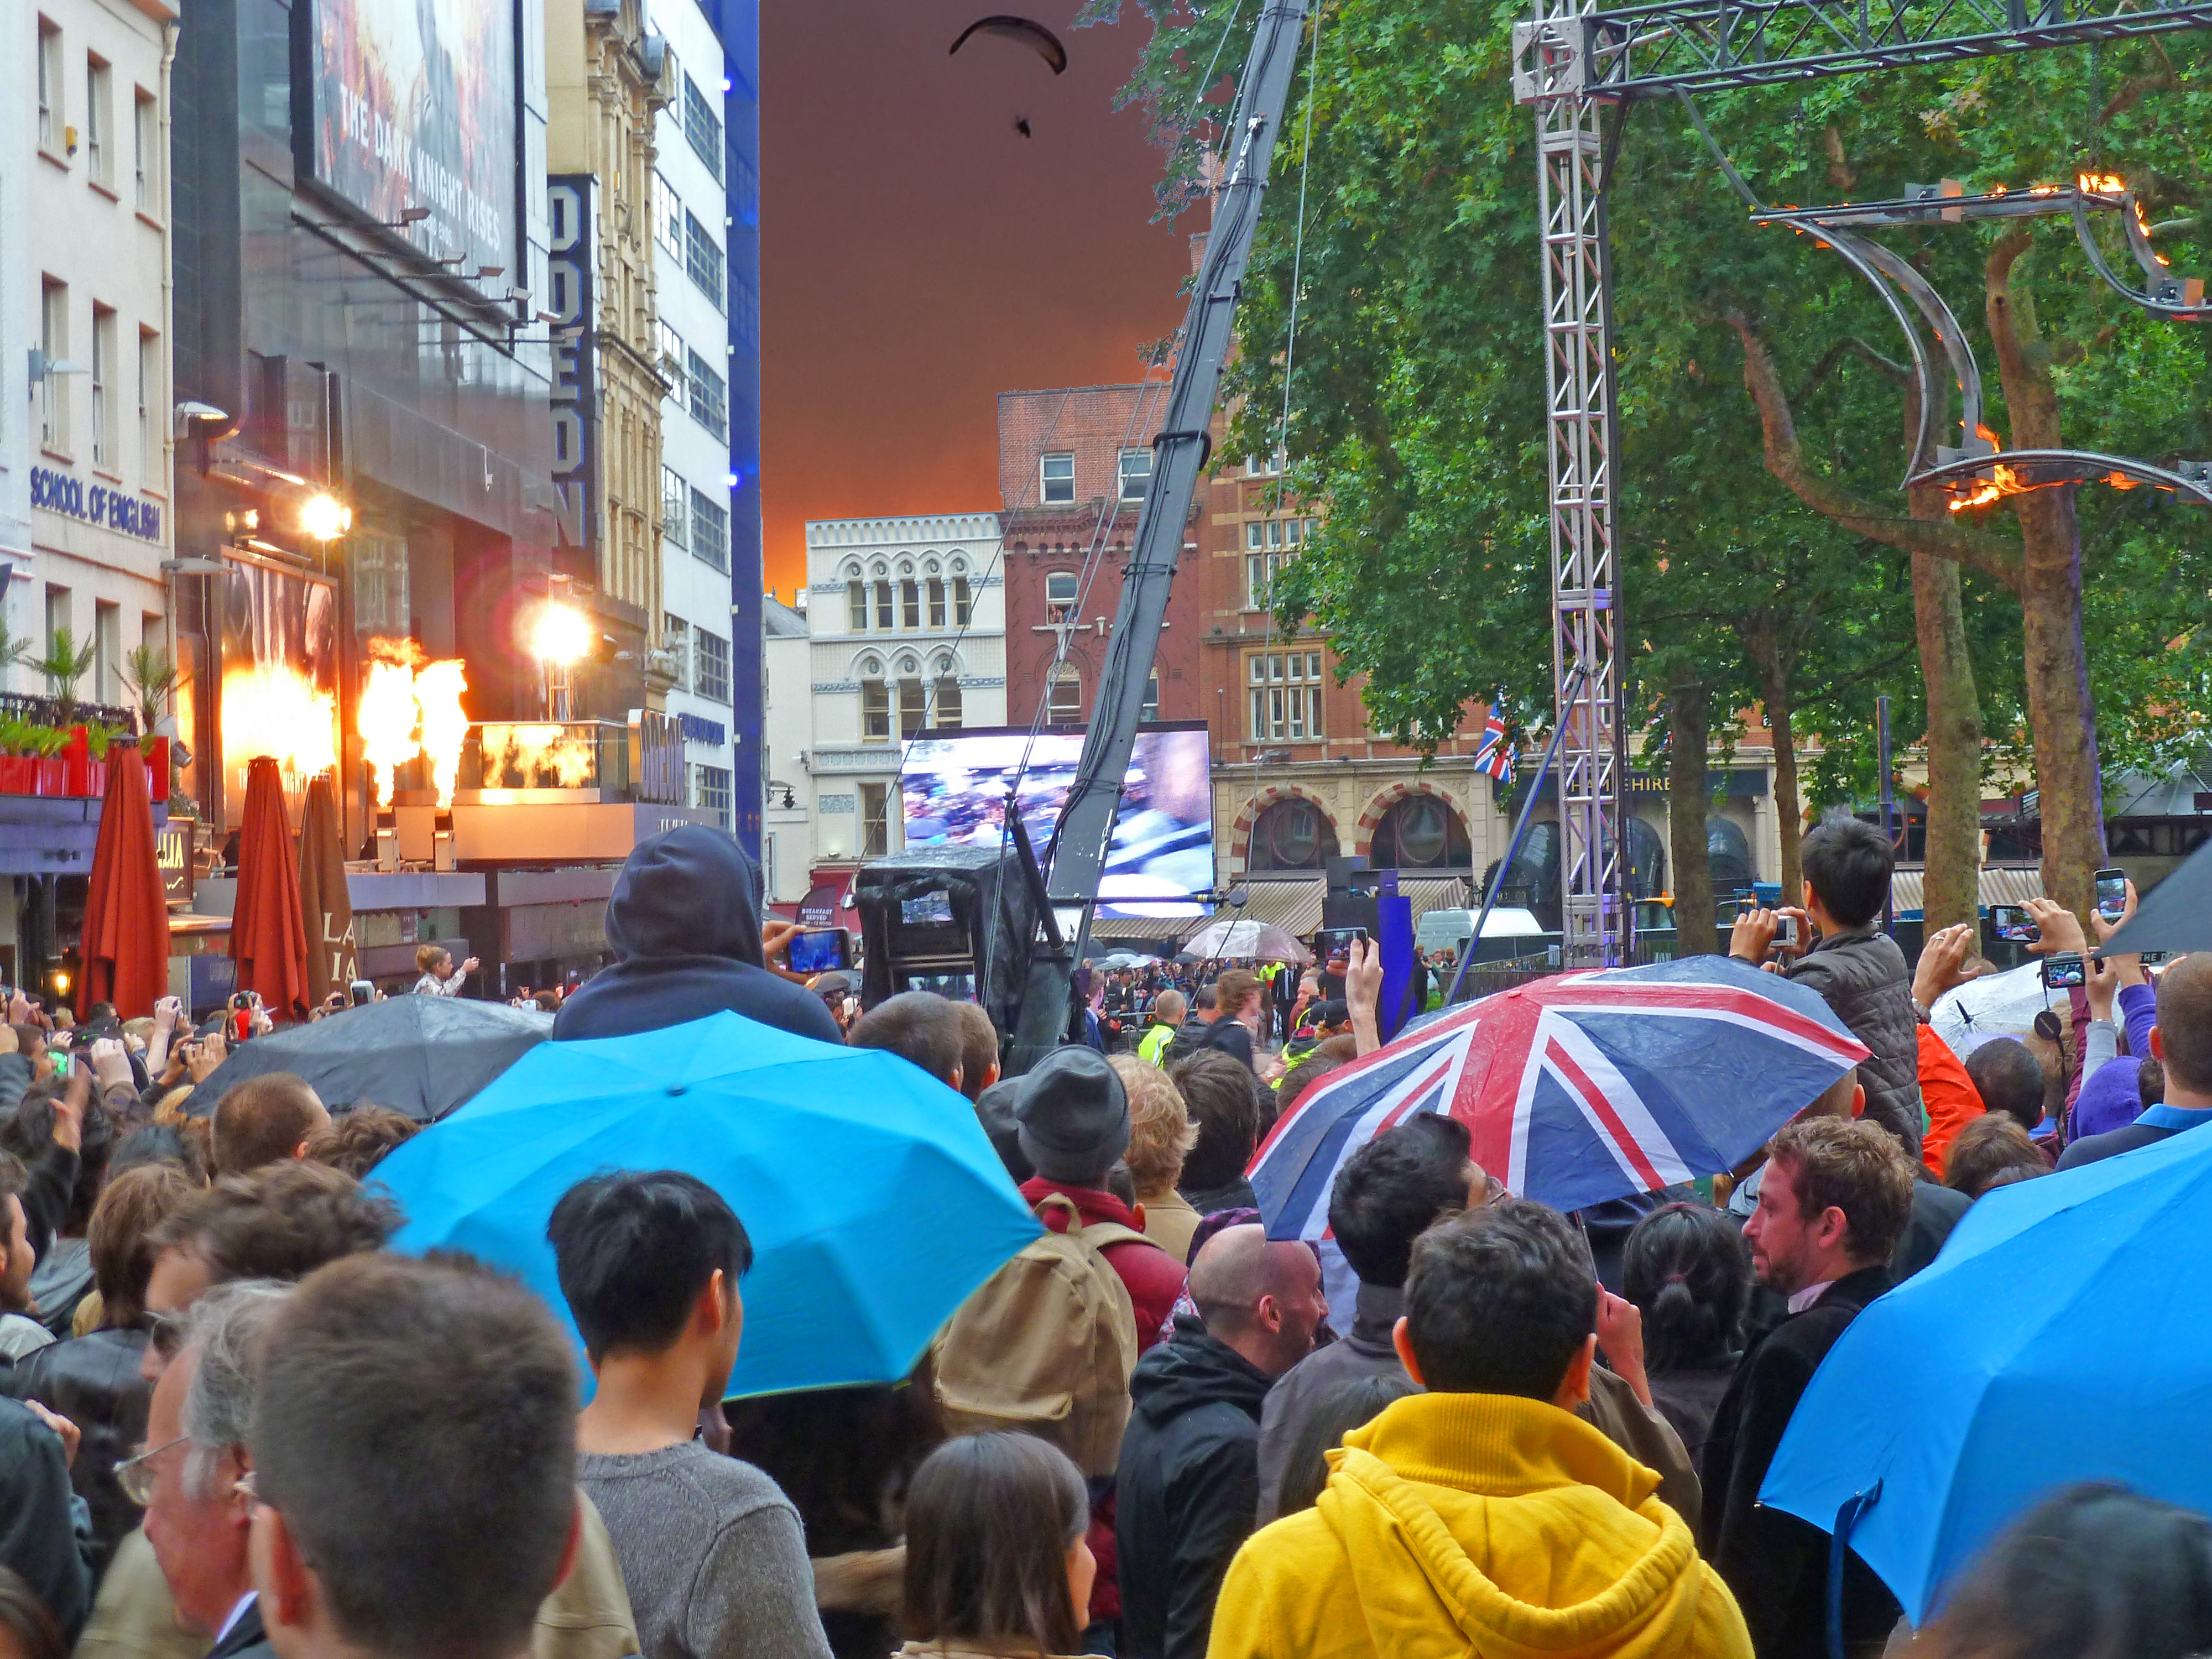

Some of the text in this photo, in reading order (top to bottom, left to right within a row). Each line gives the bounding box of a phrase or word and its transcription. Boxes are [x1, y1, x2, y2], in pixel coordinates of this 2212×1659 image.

[340, 82, 500, 252] THE DARK KNIGHT RISES
[547, 185, 586, 548] ODEON
[30, 466, 160, 542] SCHOOL OF ENGLISH
[238, 768, 305, 794] TH NIGHT
[324, 912, 356, 948] LA
[2140, 953, 2157, 961] THE
